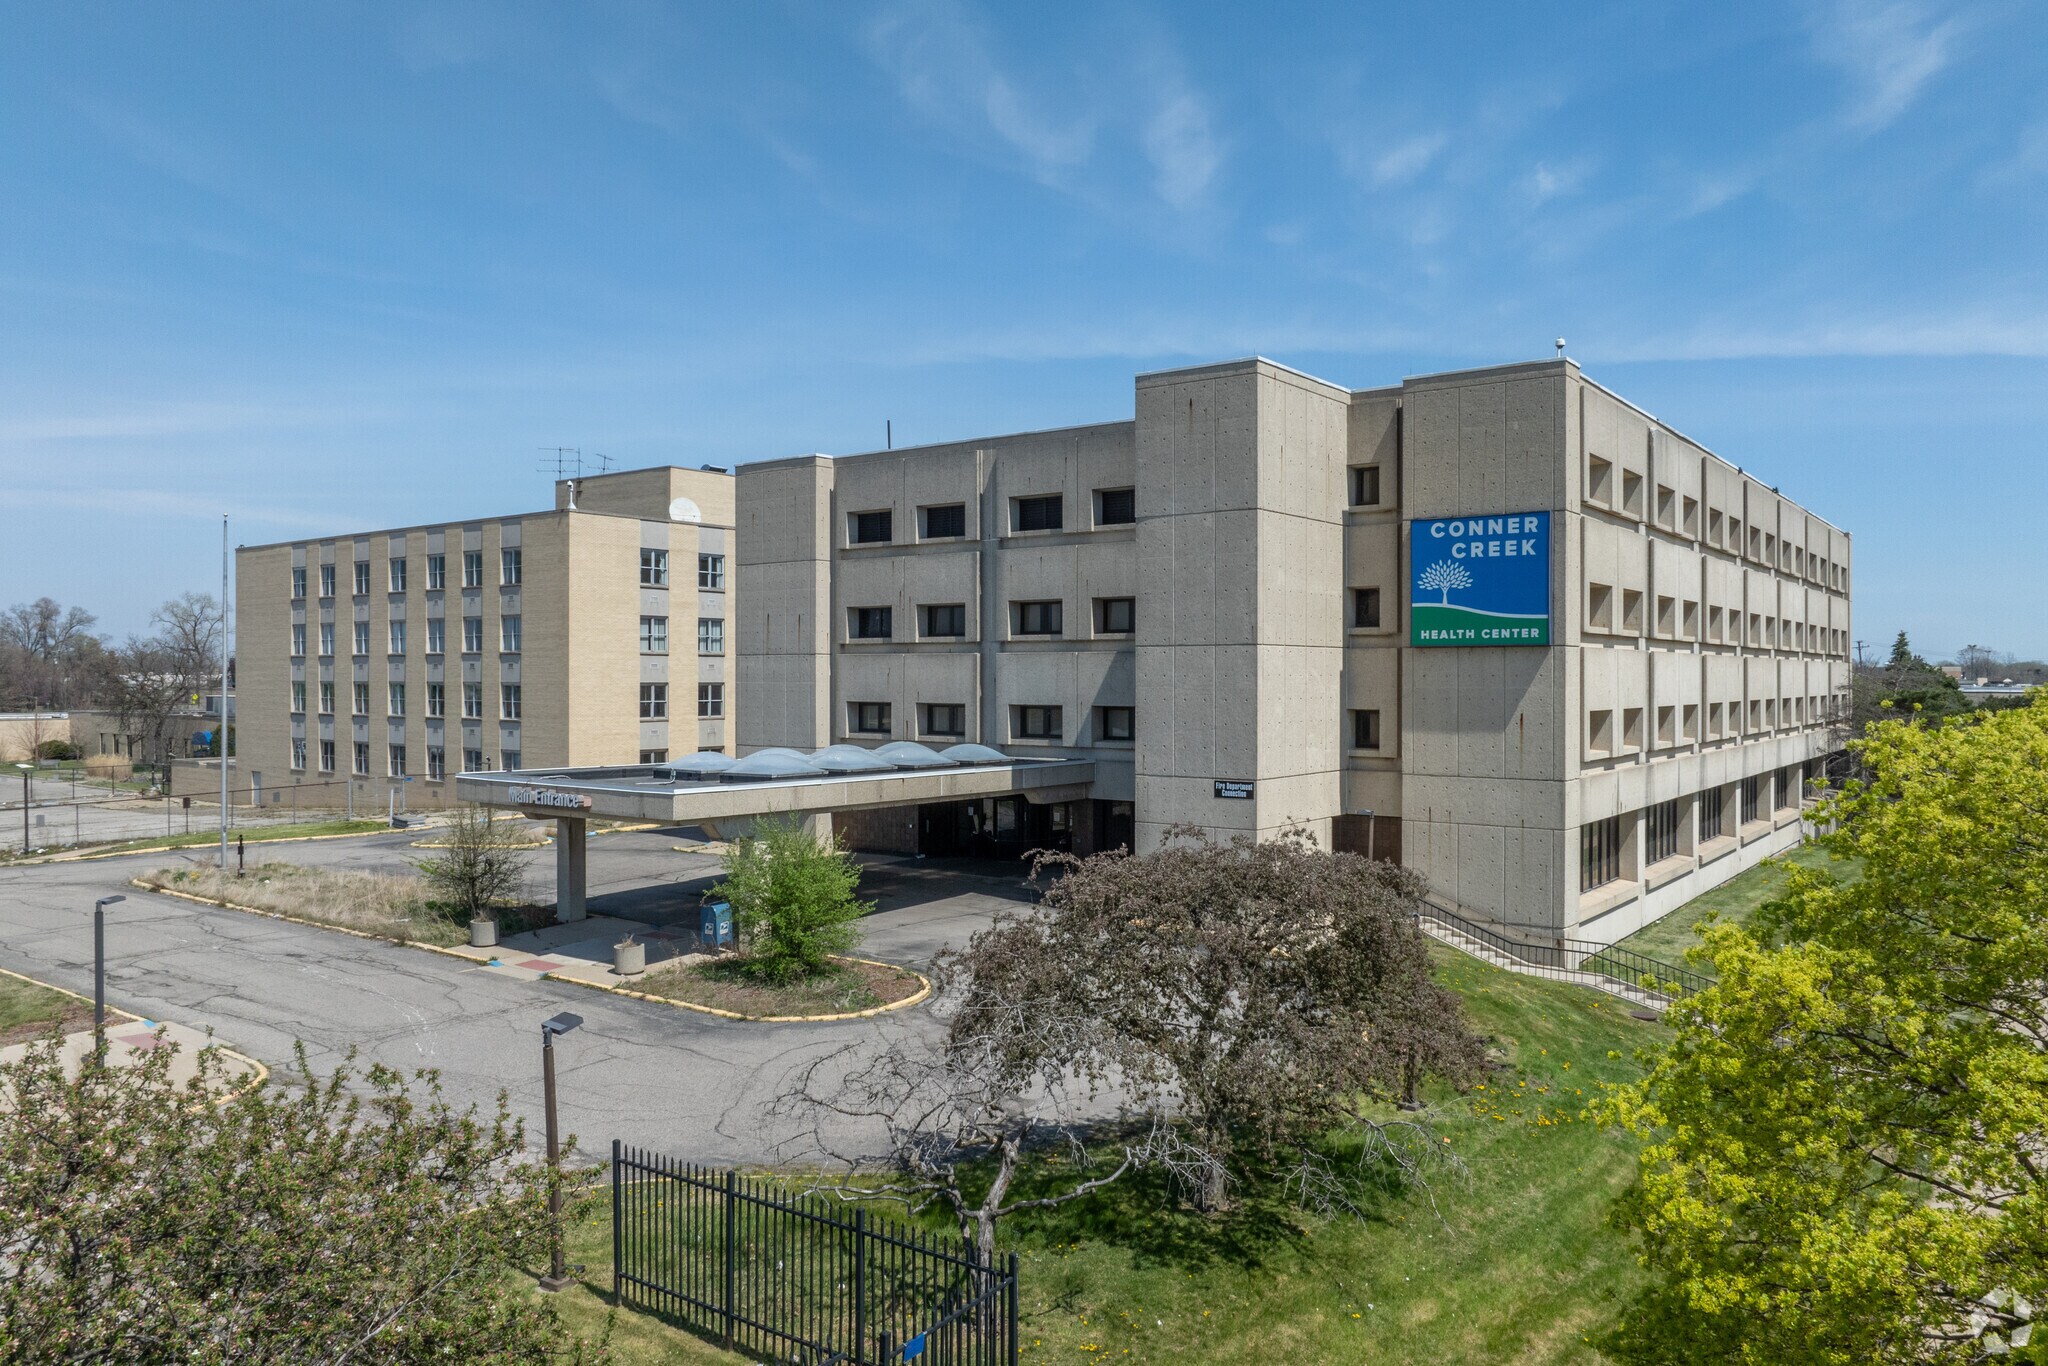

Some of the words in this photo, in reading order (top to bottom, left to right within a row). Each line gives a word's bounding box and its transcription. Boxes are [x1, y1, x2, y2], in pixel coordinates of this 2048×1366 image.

[1430, 517, 1538, 538] CONNER
[1451, 539, 1536, 558] CREEK
[1420, 629, 1475, 640] HEALTH
[1481, 628, 1540, 639] CENTER
[508, 786, 532, 804] Main
[535, 789, 579, 808] Entrance
